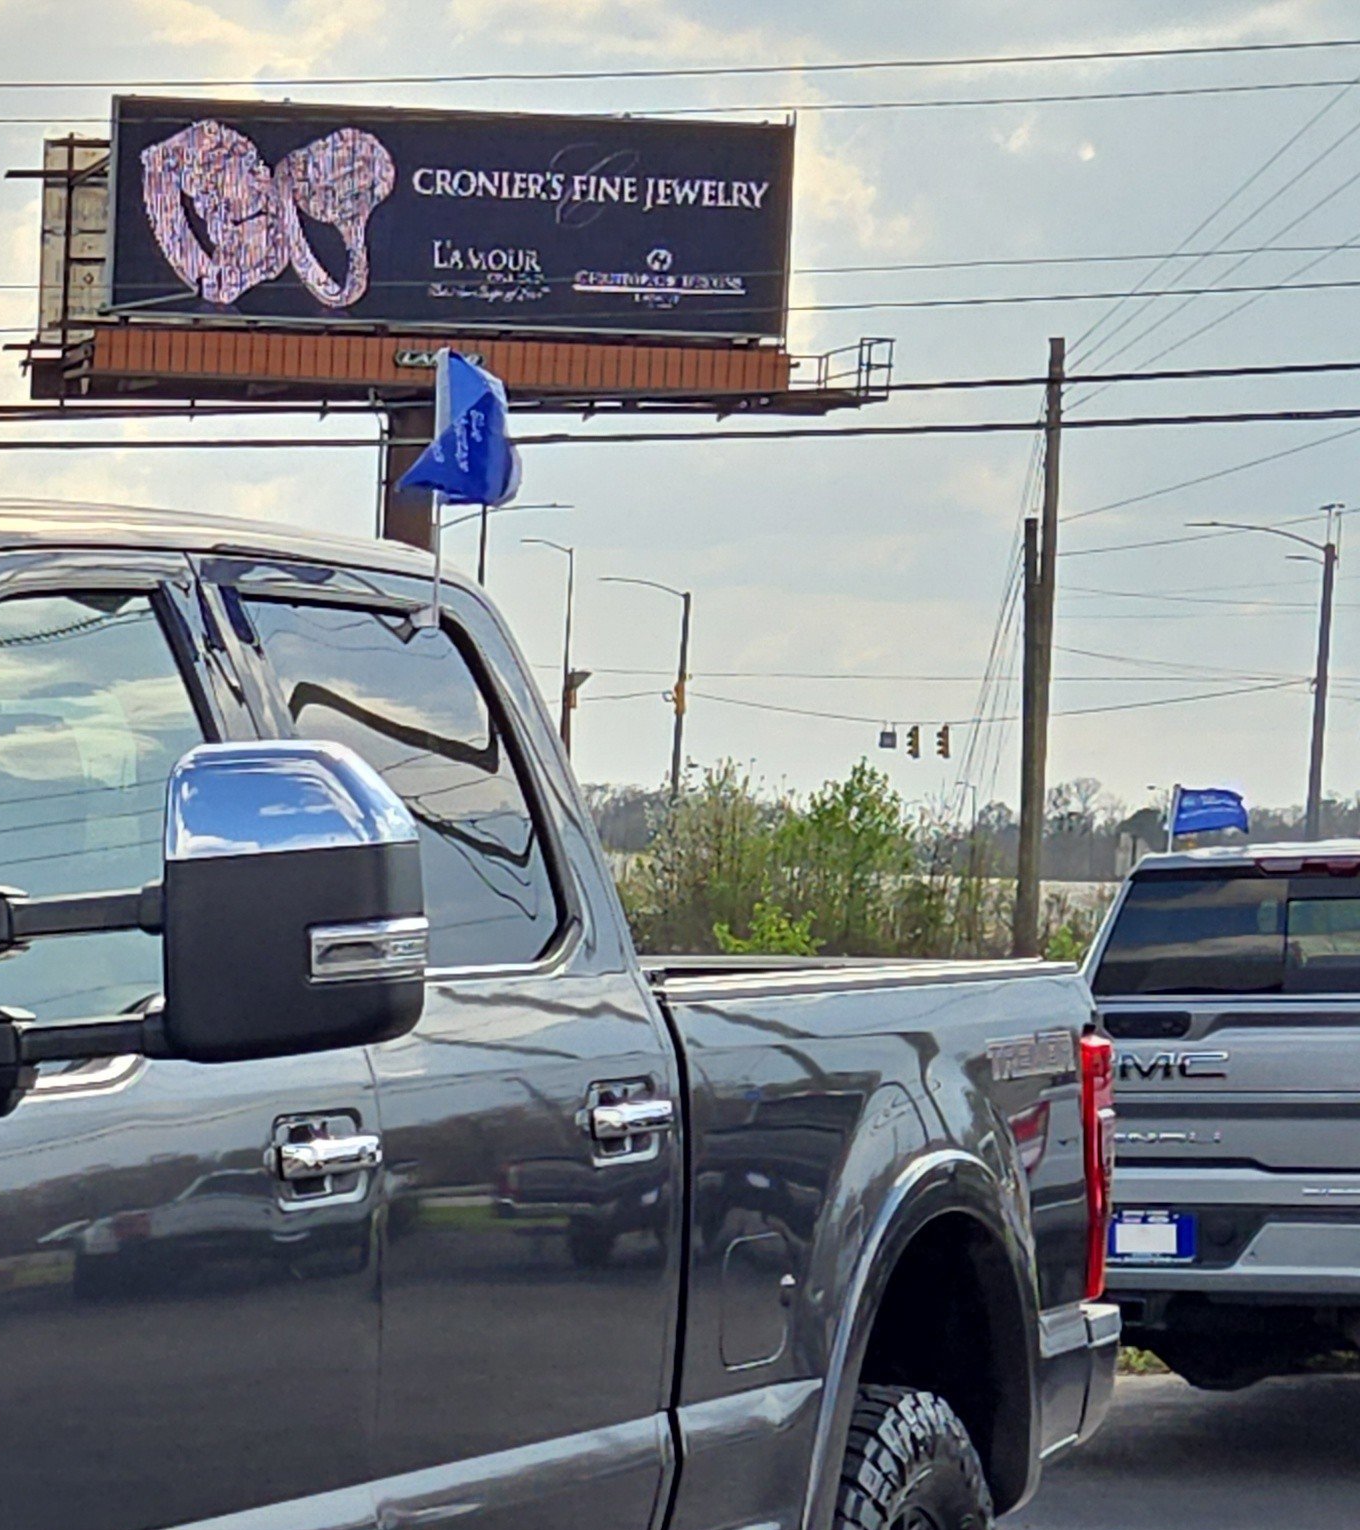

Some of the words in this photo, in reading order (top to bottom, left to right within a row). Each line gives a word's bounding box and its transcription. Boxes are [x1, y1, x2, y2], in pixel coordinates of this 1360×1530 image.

[412, 167, 565, 201] CRONIER'S
[571, 174, 639, 204] FINE
[642, 176, 770, 213] JEWELRY
[1112, 1050, 1230, 1079] MC
